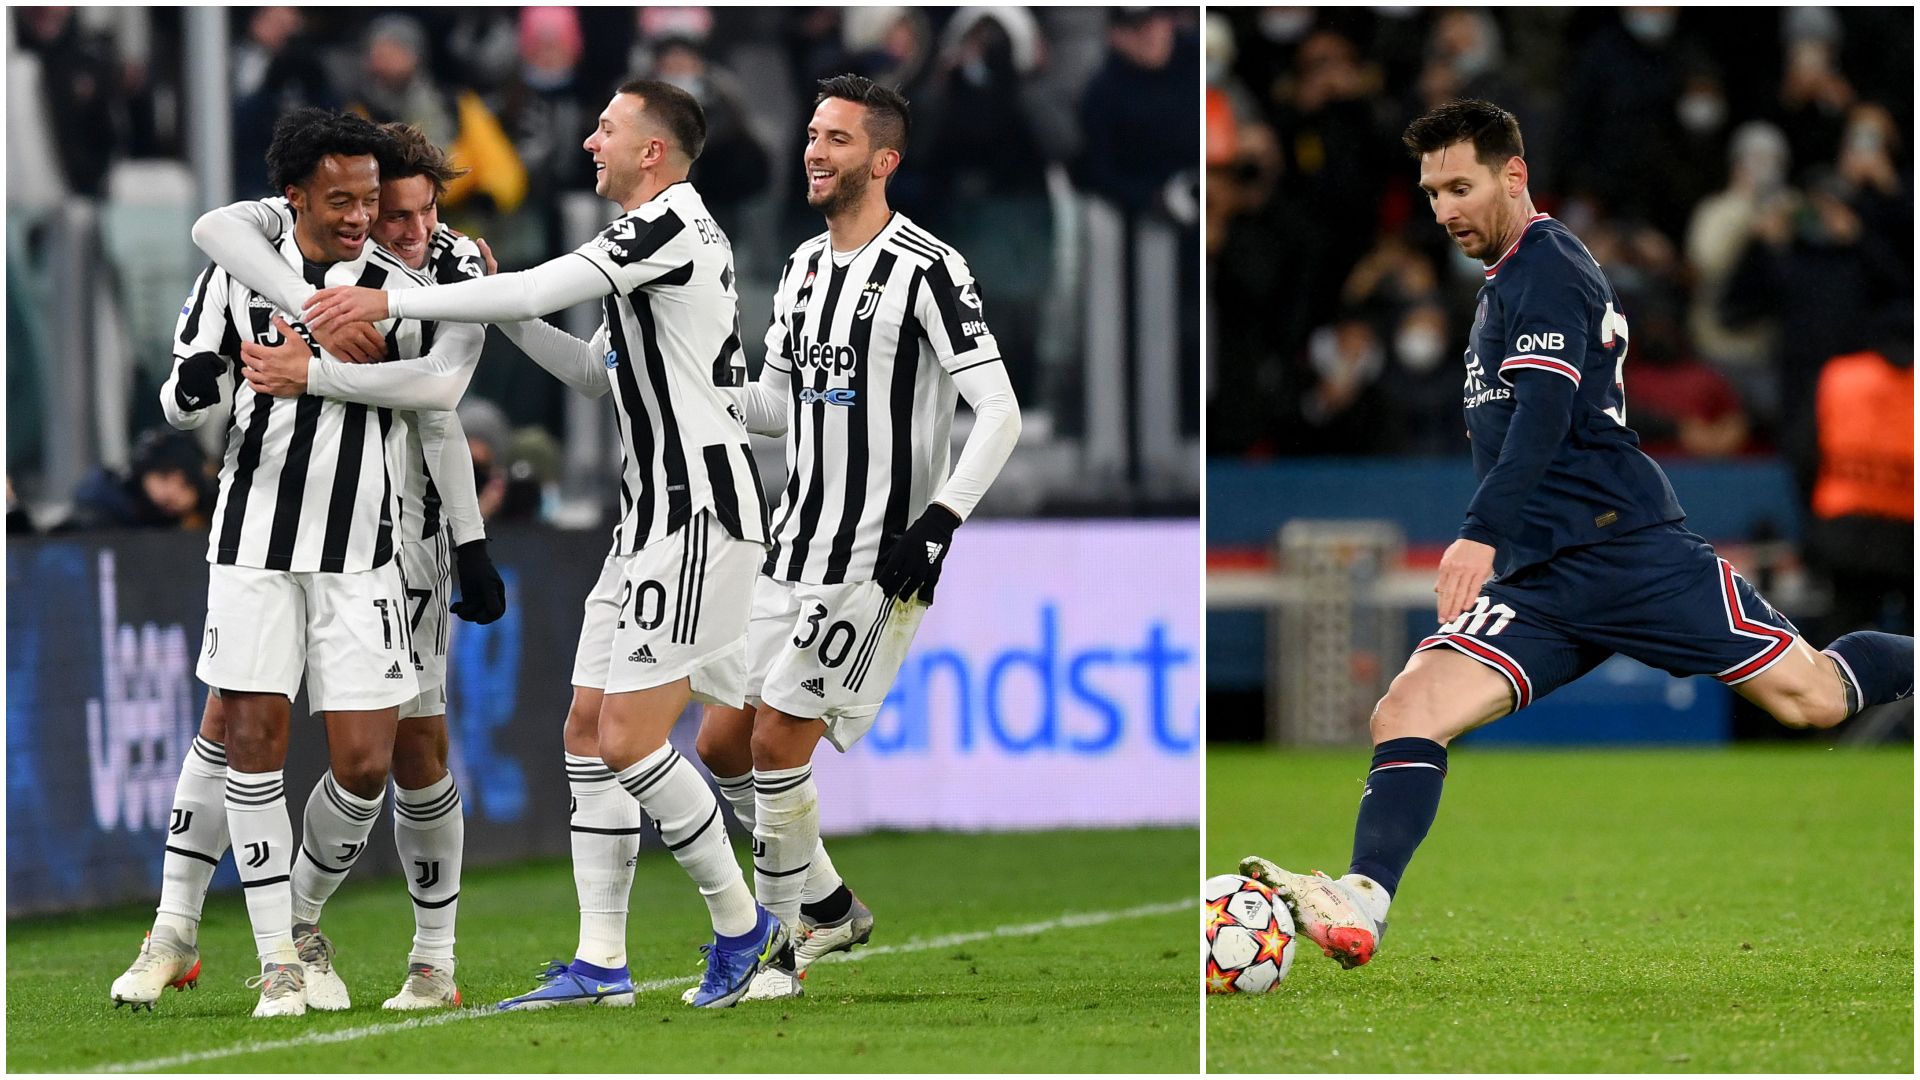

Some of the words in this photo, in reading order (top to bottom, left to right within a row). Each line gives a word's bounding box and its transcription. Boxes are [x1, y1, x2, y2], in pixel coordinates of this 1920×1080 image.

[794, 335, 855, 377] Jeep
[1516, 332, 1565, 352] QNB
[373, 599, 405, 650] 11
[793, 603, 857, 668] 30
[628, 655, 657, 664] adidas
